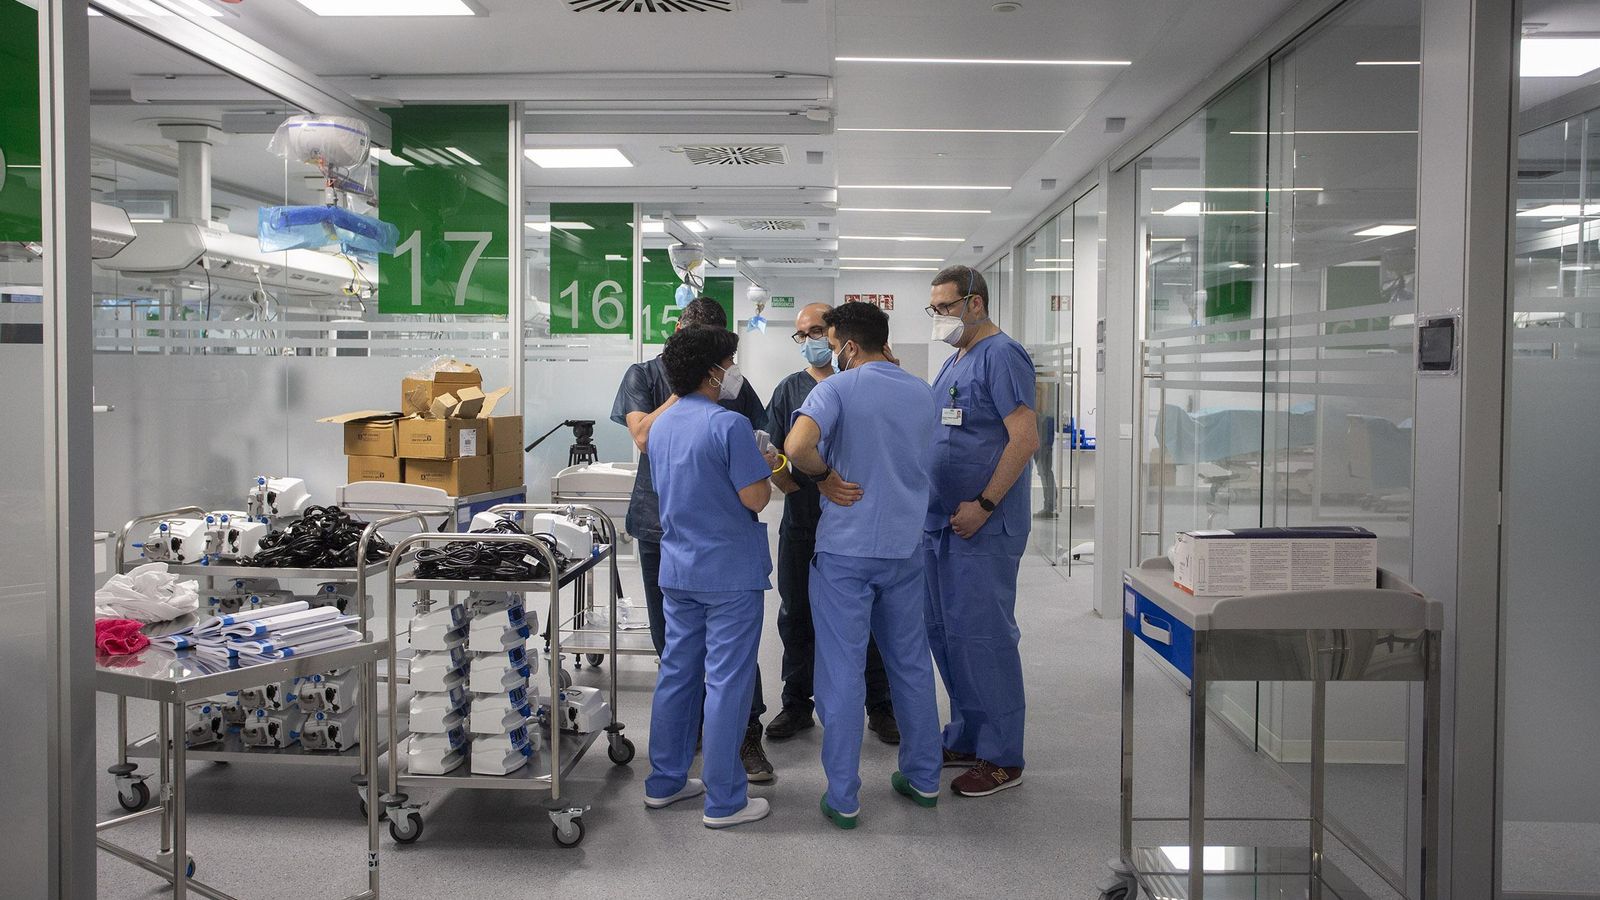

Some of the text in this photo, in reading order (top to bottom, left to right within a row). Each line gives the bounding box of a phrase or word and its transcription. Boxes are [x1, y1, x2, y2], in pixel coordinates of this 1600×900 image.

[393, 230, 493, 306] 17
[559, 280, 624, 329] 16
[642, 304, 682, 341] 15
[991, 767, 1010, 784] N
